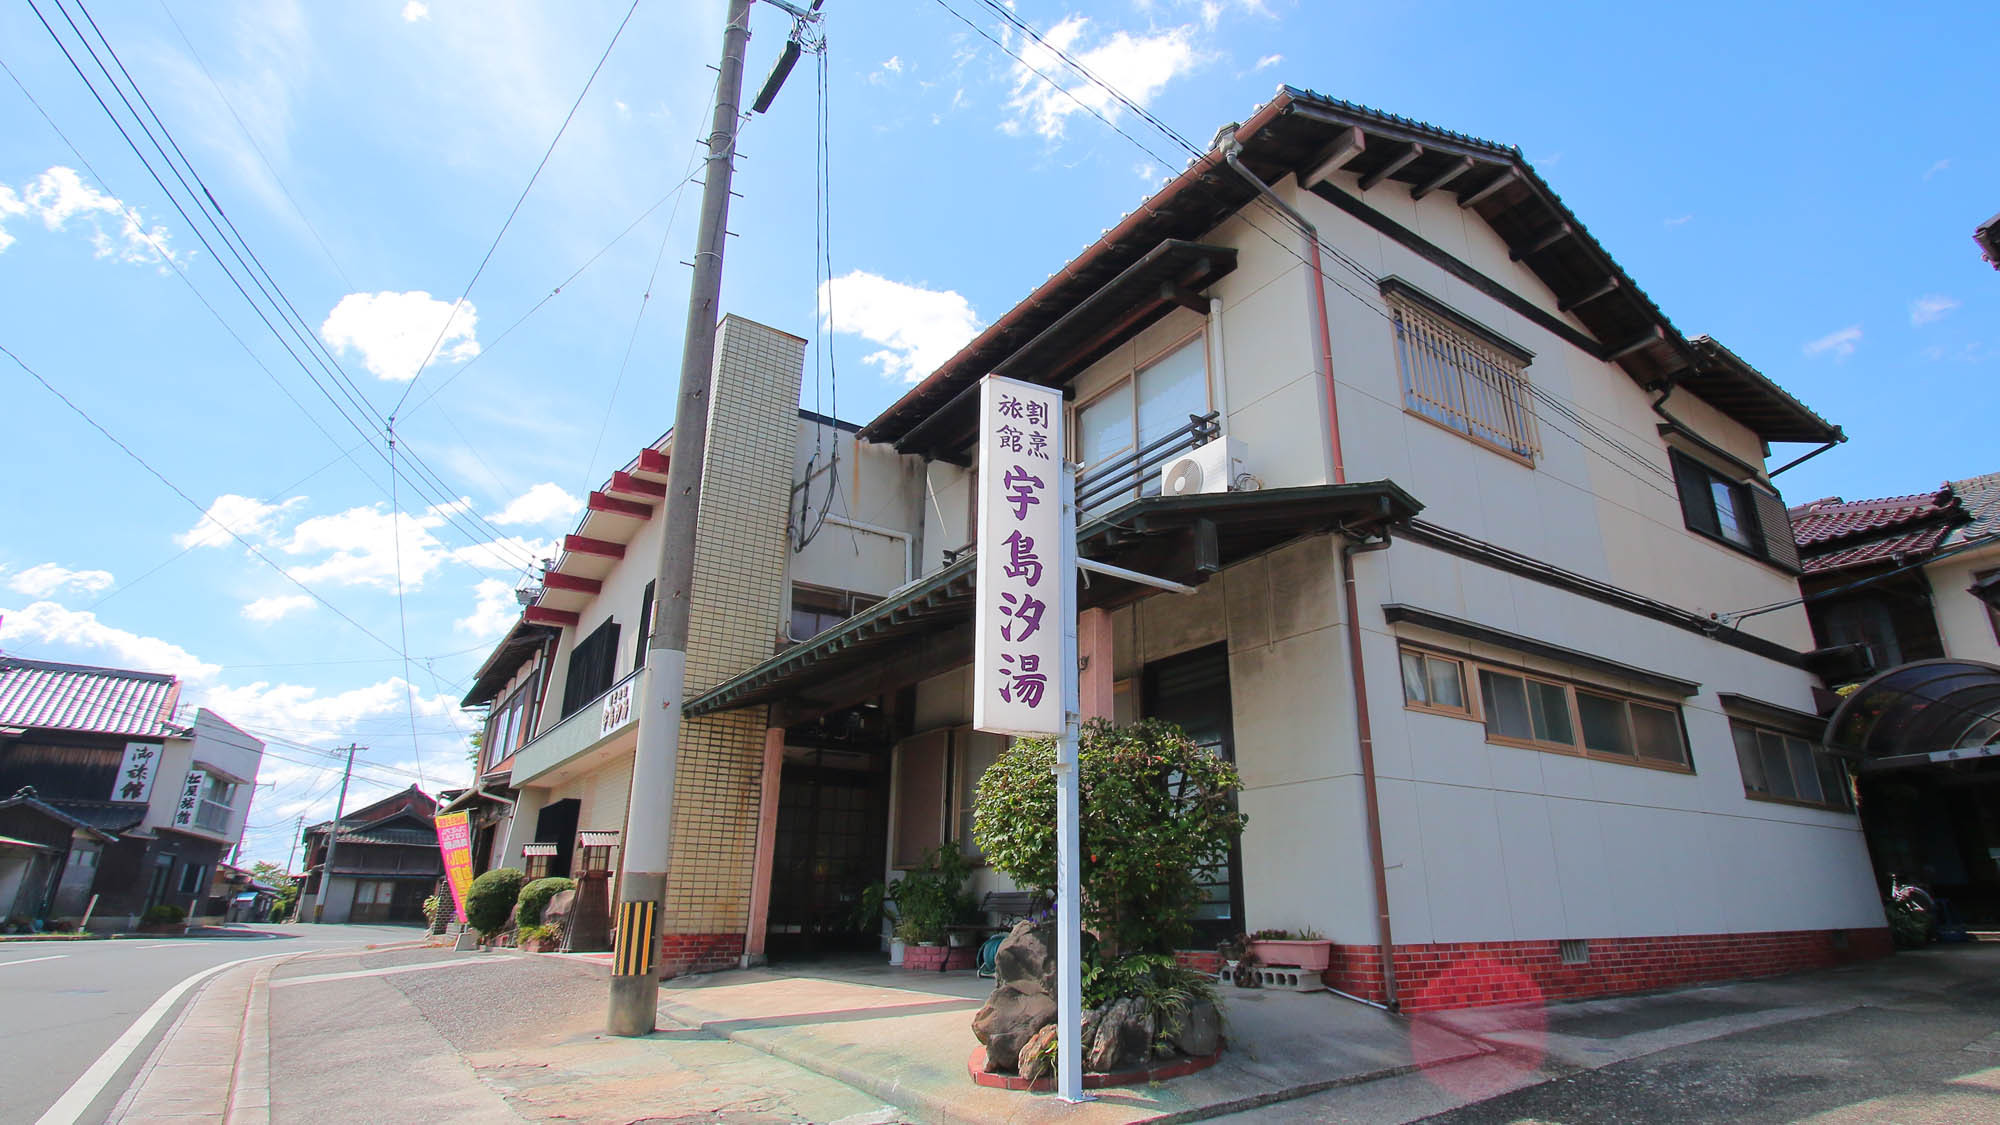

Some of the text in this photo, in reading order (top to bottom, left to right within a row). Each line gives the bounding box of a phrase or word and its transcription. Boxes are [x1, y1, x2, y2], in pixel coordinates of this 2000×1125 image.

[996, 394, 1023, 452] 旅館
[1026, 401, 1049, 460] 割烹
[998, 465, 1048, 708] 宇島汐湯
